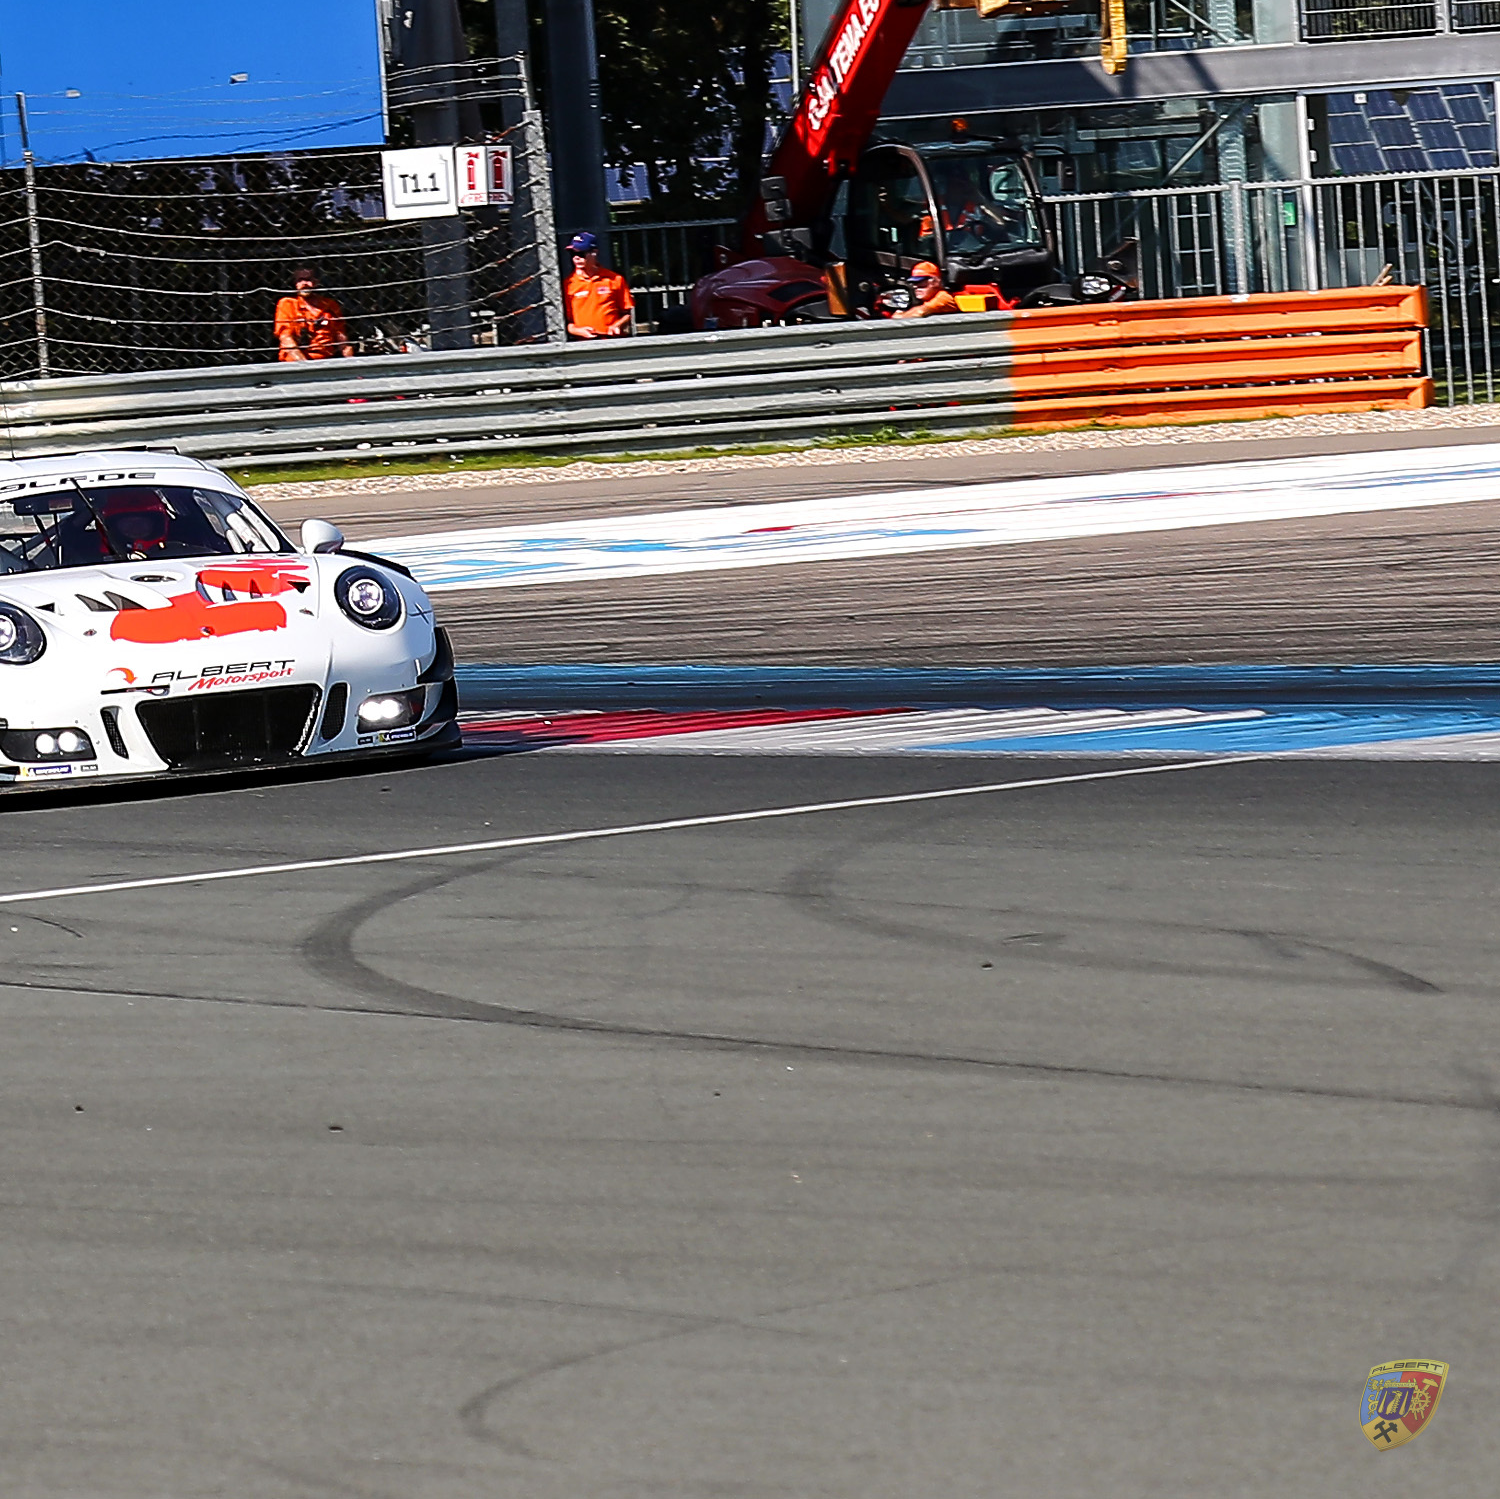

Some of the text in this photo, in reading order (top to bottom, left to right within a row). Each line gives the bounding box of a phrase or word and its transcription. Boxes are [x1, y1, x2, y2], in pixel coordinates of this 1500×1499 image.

[398, 172, 440, 193] T1.1
[151, 659, 296, 684] ALBERT
[187, 667, 296, 692] Motorsport
